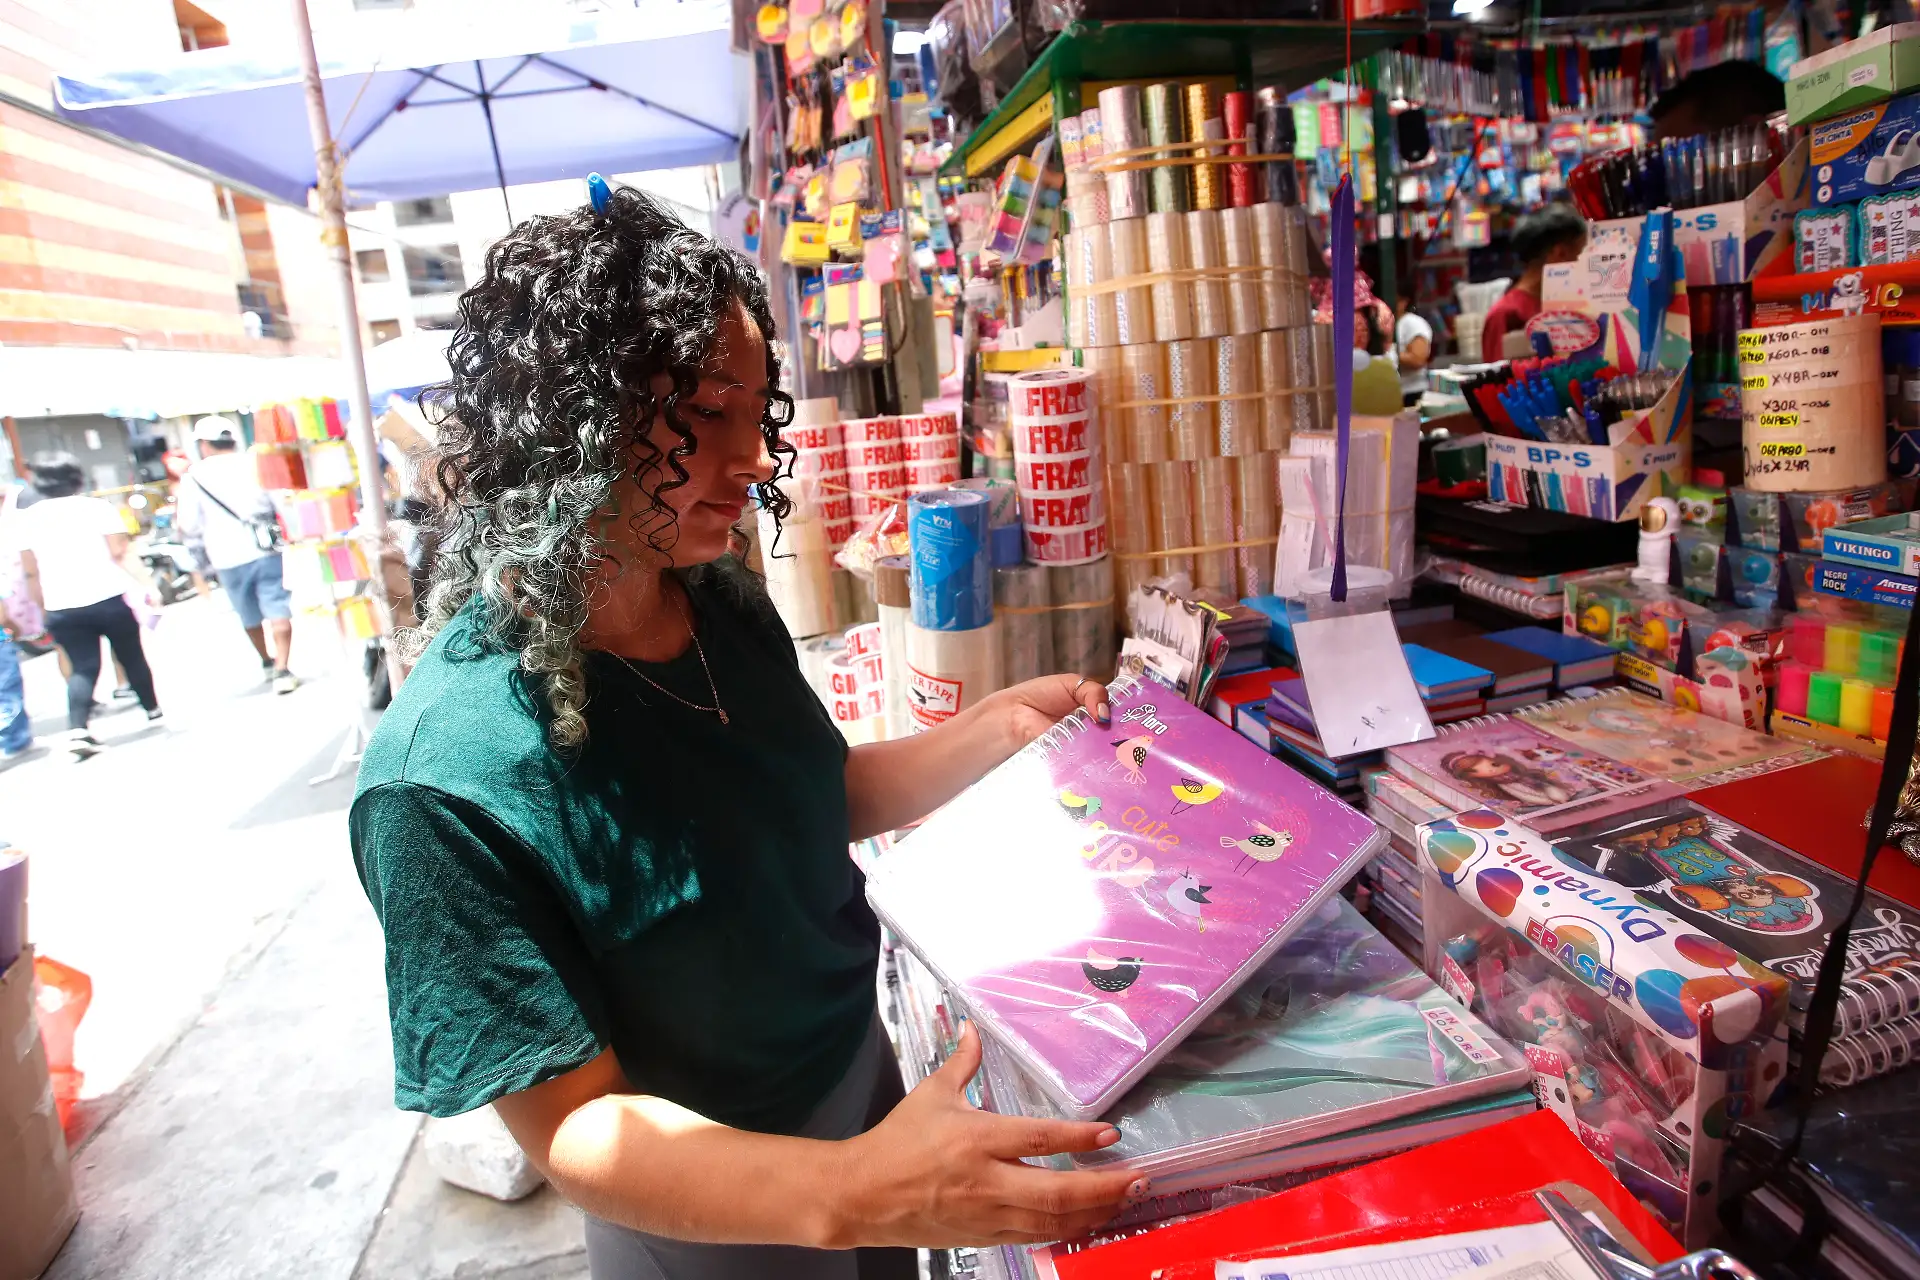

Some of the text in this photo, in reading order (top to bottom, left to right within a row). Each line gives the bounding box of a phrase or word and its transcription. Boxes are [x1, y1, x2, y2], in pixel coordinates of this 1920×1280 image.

[1653, 452, 1677, 463] PILOT
[1834, 540, 1892, 560] VIKINGO
[1822, 578, 1847, 592] ROCK
[1824, 569, 1848, 580] NEGRO
[927, 678, 955, 705] TAPE
[1141, 713, 1168, 736] loro
[1496, 842, 1667, 943] Dynamic
[1525, 916, 1635, 1006] ERASER
[1438, 1010, 1459, 1025] IN
[1428, 1011, 1483, 1061] COLORS
